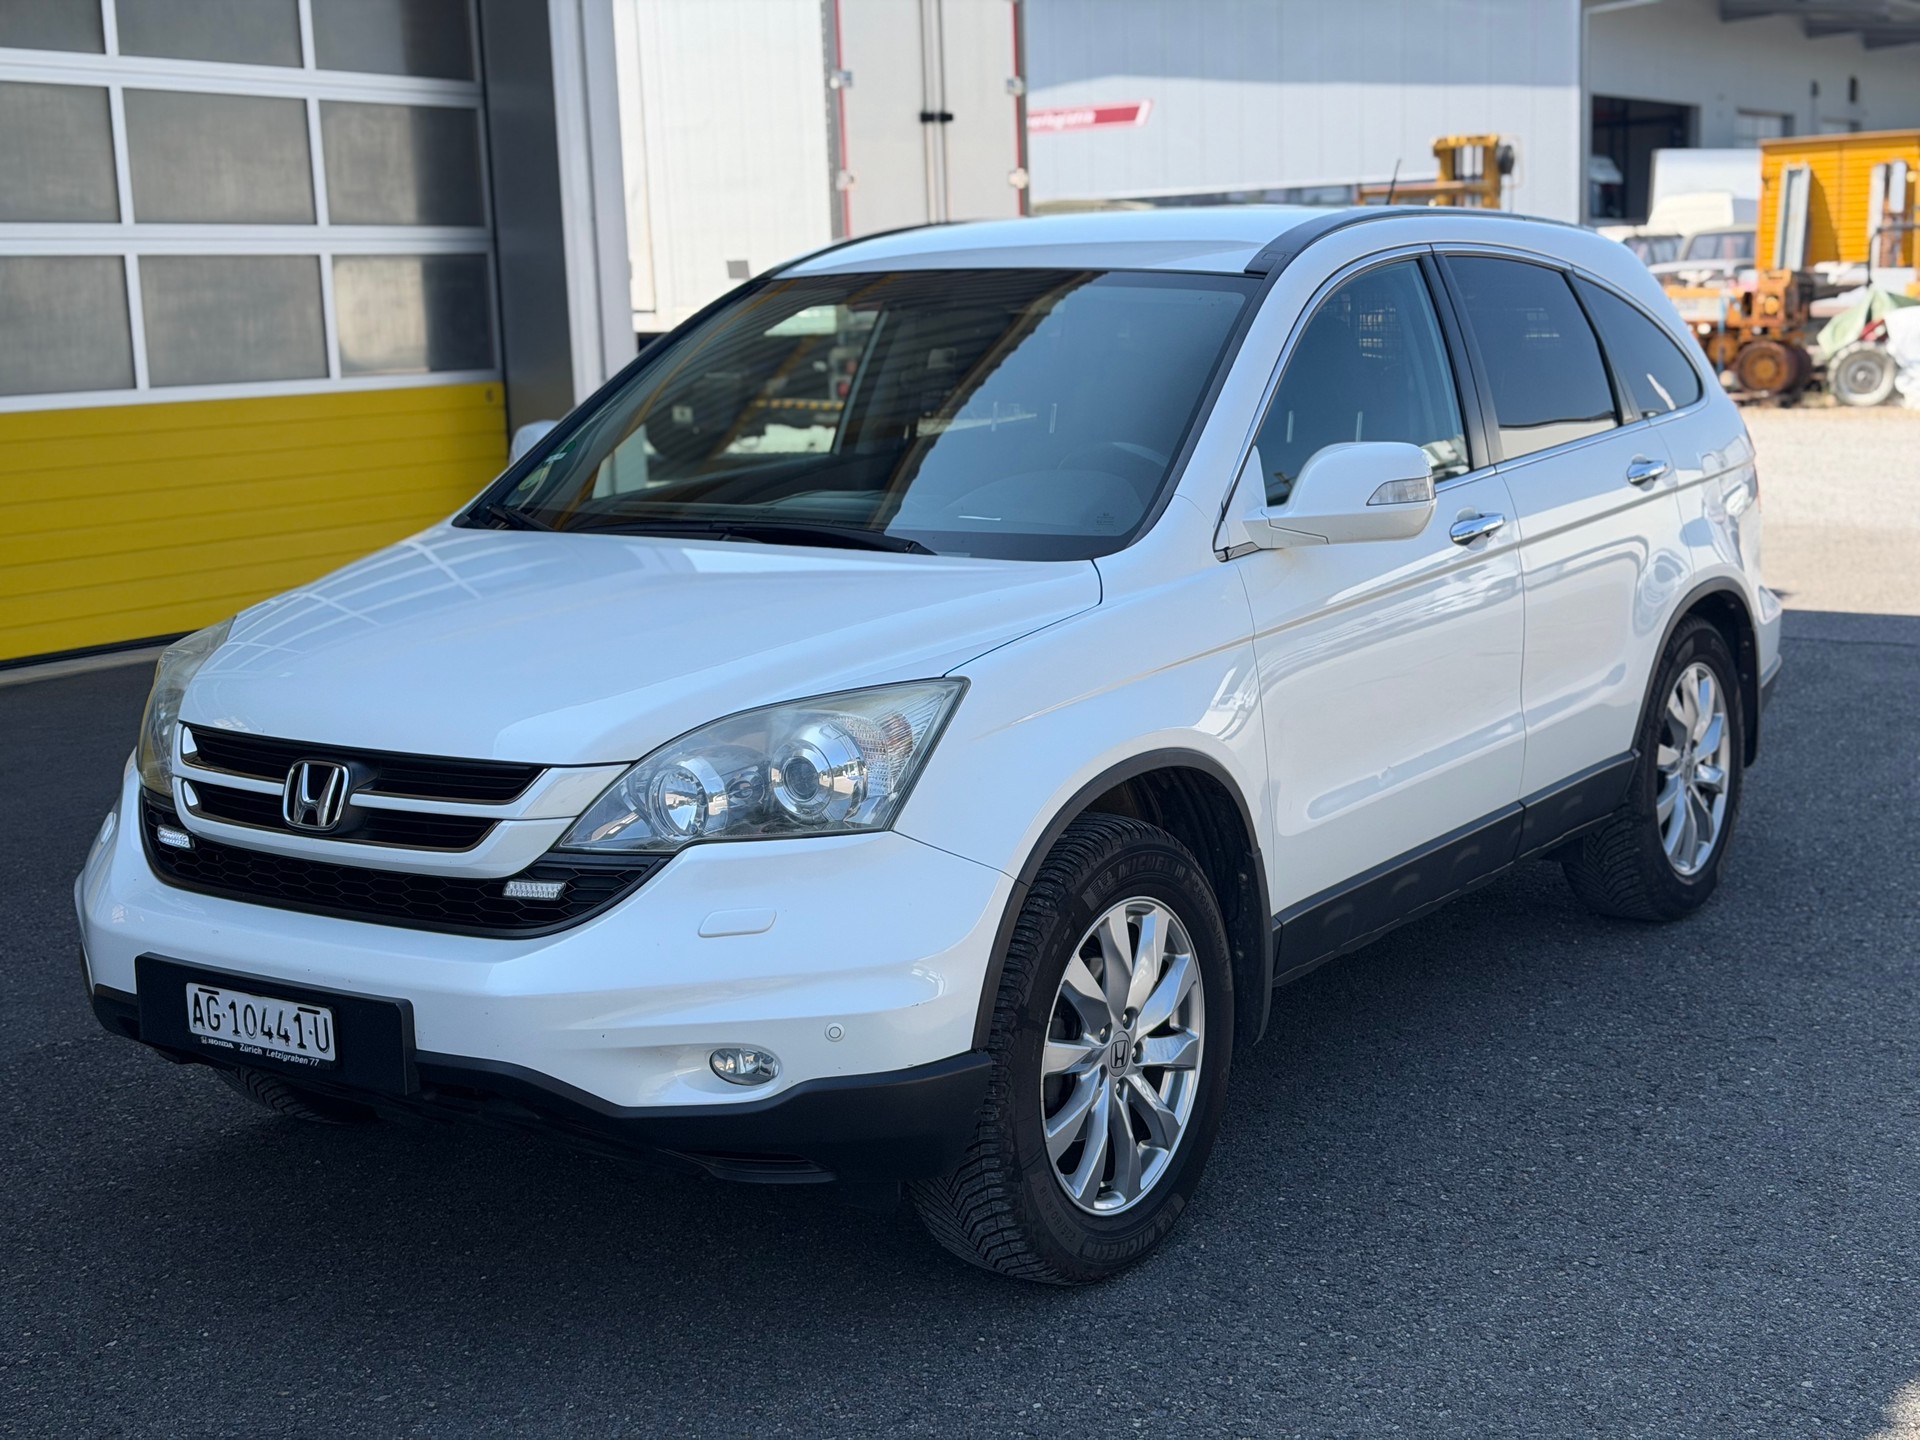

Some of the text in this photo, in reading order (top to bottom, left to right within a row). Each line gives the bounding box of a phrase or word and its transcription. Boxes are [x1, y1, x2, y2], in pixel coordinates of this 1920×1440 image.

[207, 1037, 235, 1049] HONDA
[239, 1043, 263, 1056] Zürich
[266, 1048, 309, 1065] Letzigraben
[1081, 1223, 1156, 1260] MICHELIN
